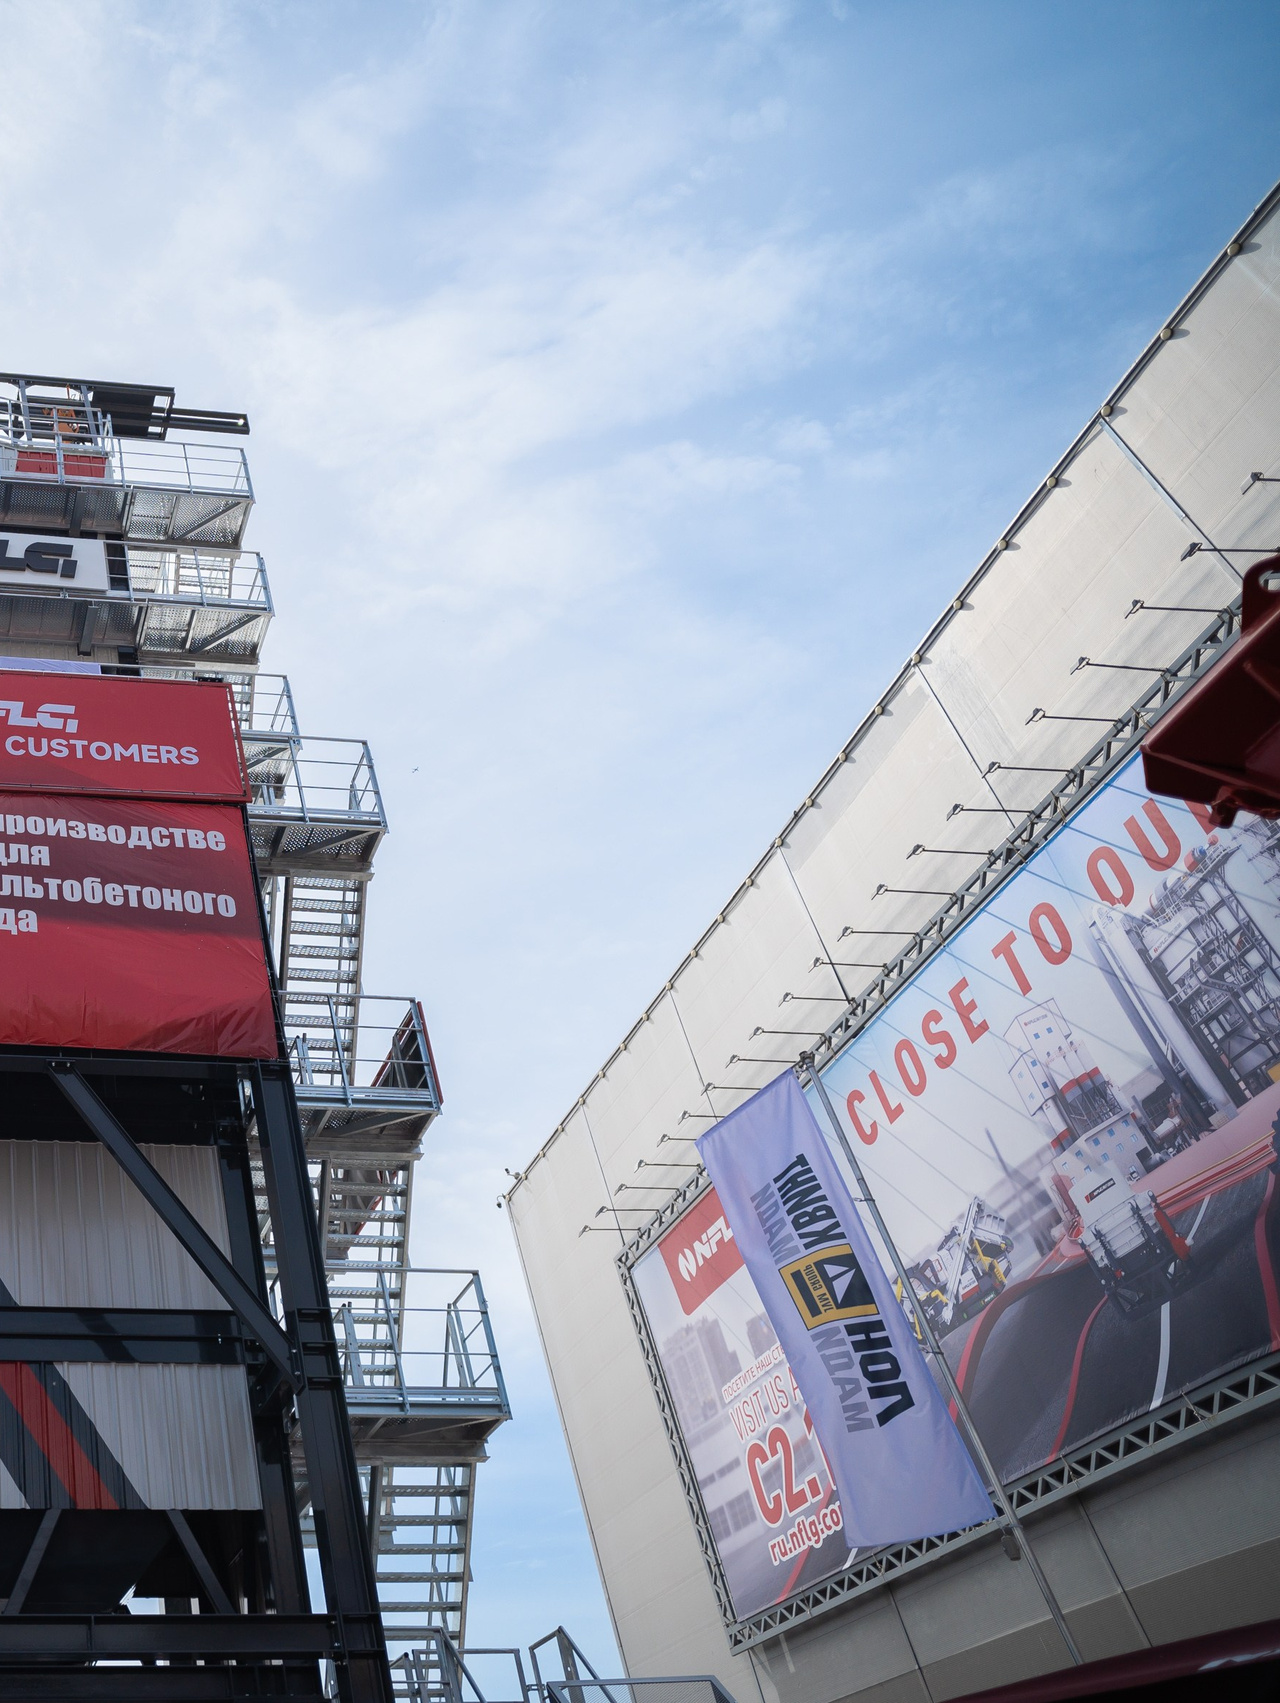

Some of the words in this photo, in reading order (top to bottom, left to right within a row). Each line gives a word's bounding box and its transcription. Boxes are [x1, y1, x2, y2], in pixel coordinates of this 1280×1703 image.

[4, 735, 200, 765] CUSTOMERS
[846, 977, 989, 1145] CLOSE
[991, 902, 1073, 997] TO
[1086, 797, 1217, 908] OU
[693, 1216, 734, 1267] NFL
[723, 1366, 756, 1401] ПОСЕТИТЕ
[755, 1354, 773, 1375] НАШ
[771, 1344, 785, 1360] СТ
[730, 1390, 767, 1441] VISIT
[764, 1375, 789, 1416] US
[747, 1407, 835, 1525] C2.
[770, 1504, 842, 1562] ru.nflg.co
